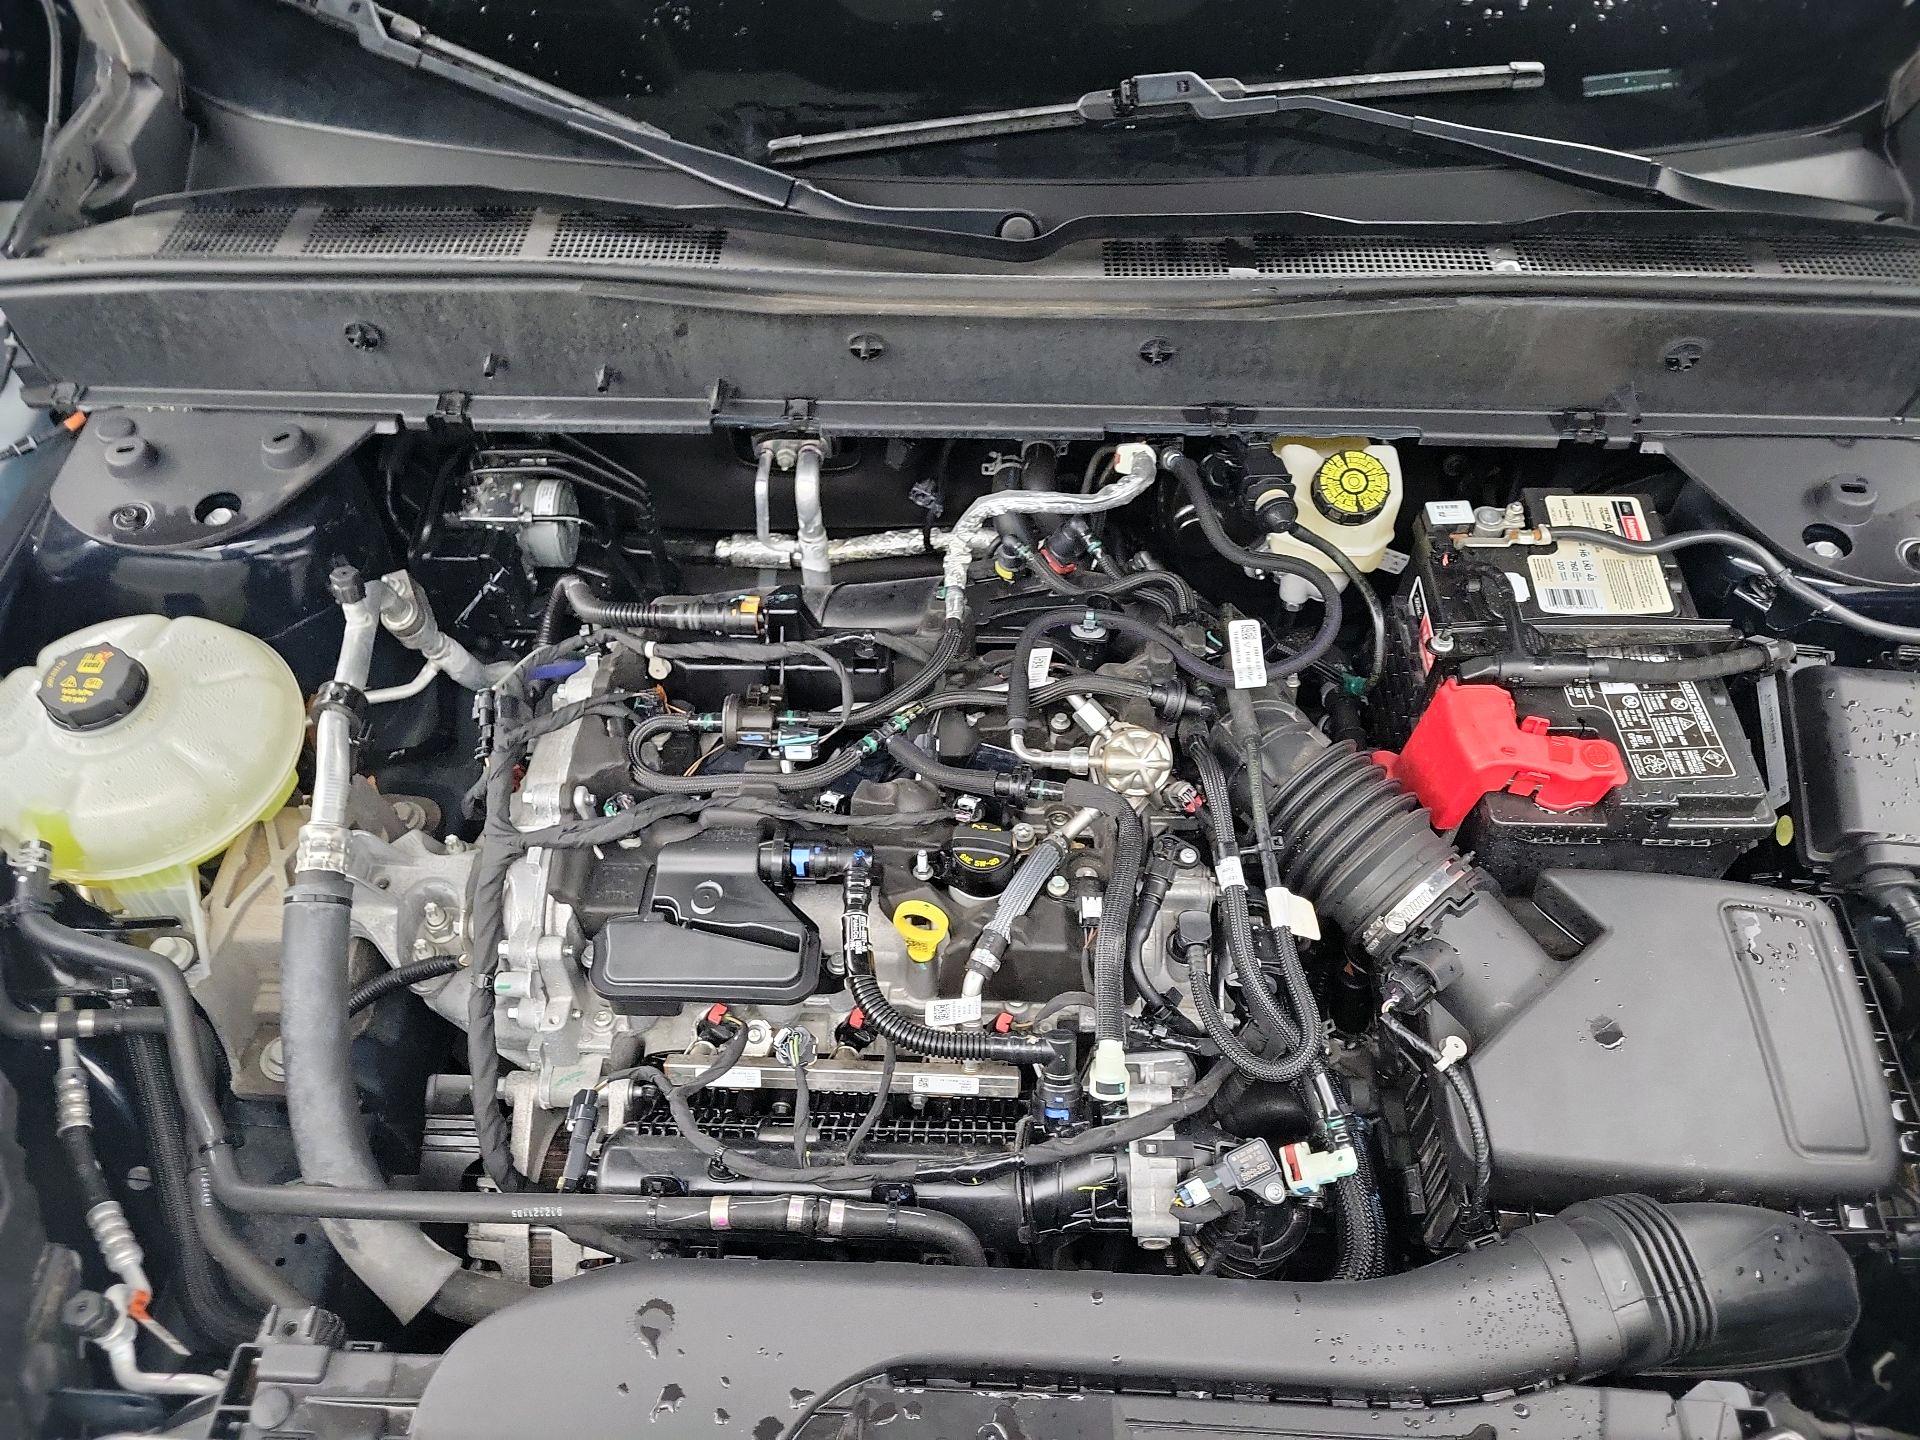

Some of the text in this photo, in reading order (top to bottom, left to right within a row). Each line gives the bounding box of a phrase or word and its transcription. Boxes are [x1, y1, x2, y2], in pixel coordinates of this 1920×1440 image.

[1636, 734, 1648, 746] NOT
[1644, 735, 1654, 744] DO
[960, 853, 1000, 867] SAE 5W-20
